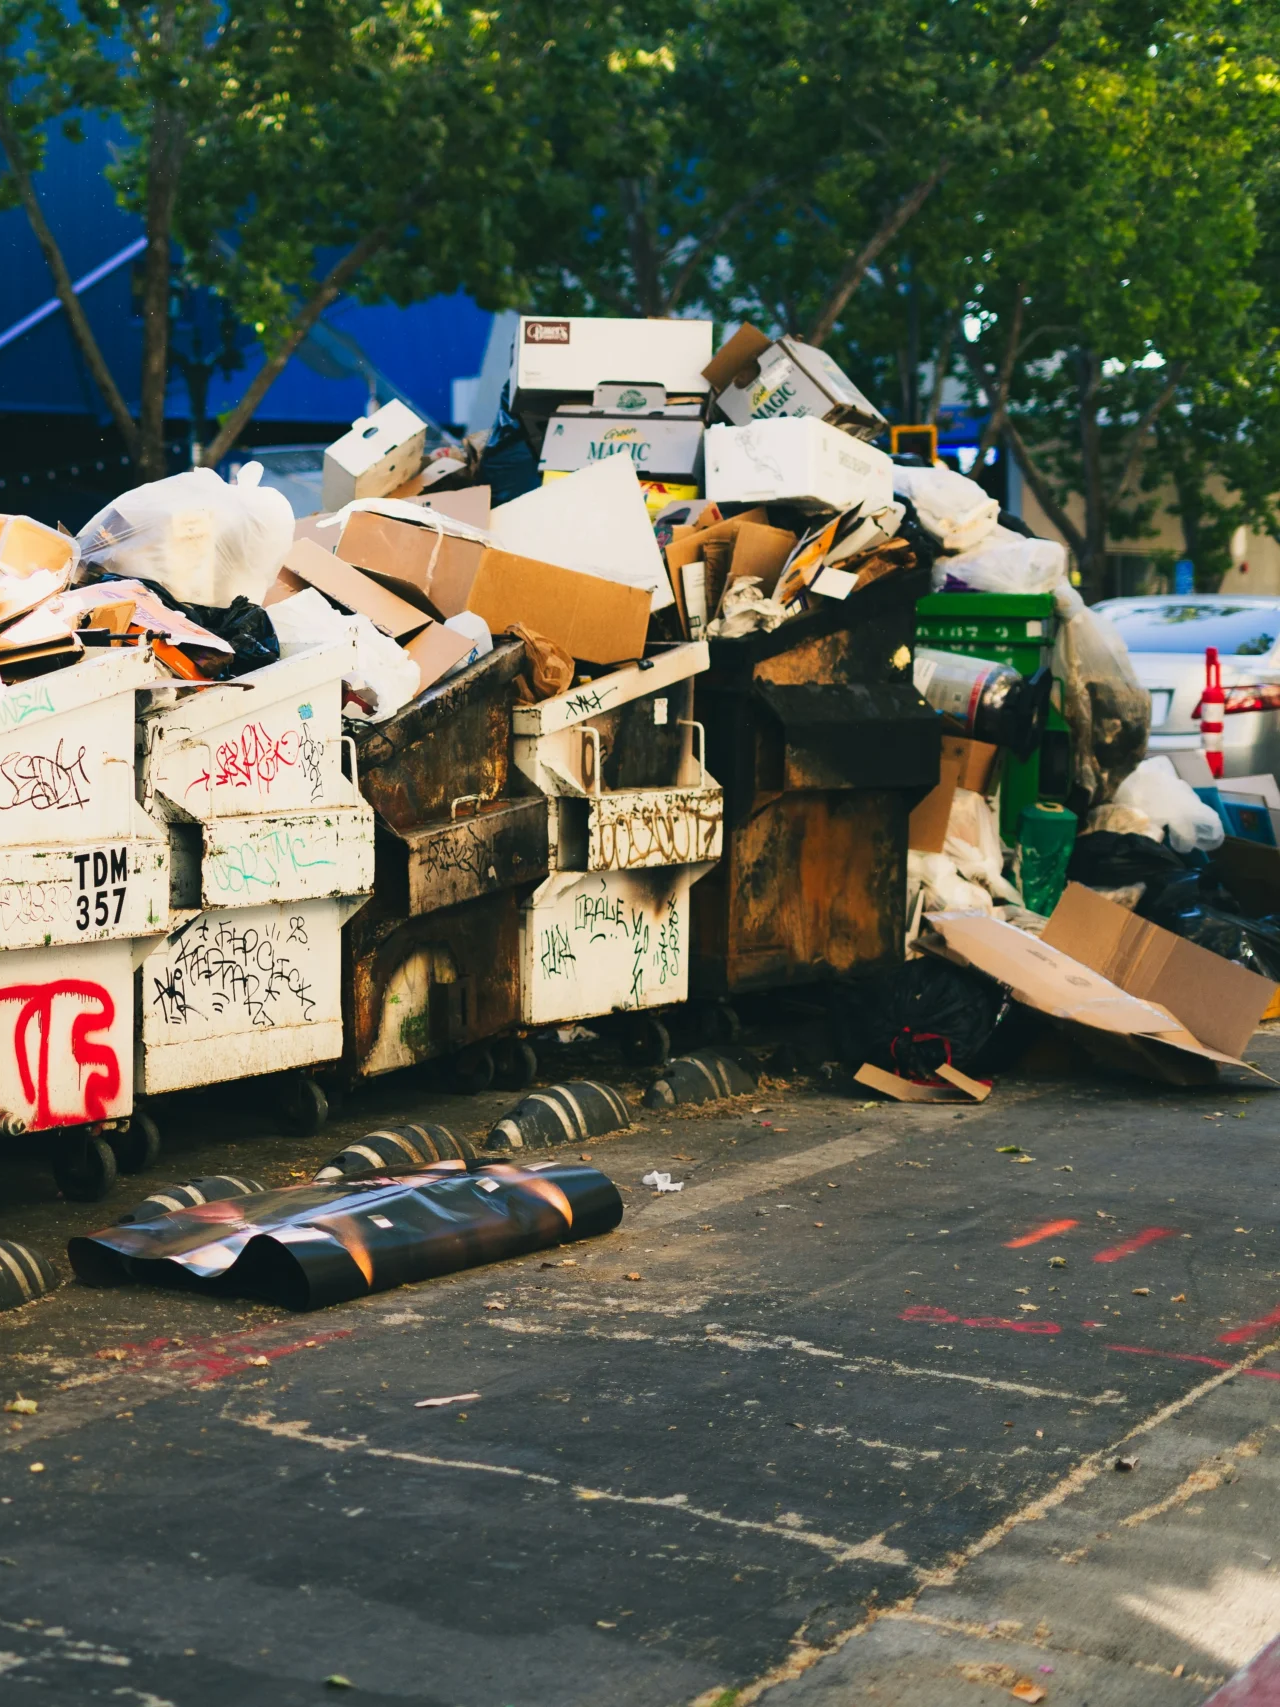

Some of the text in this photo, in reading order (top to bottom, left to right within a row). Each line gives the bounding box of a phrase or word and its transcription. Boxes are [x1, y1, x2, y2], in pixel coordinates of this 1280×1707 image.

[604, 427, 637, 440] Green
[73, 847, 128, 890] TDM
[76, 887, 127, 931] 357
